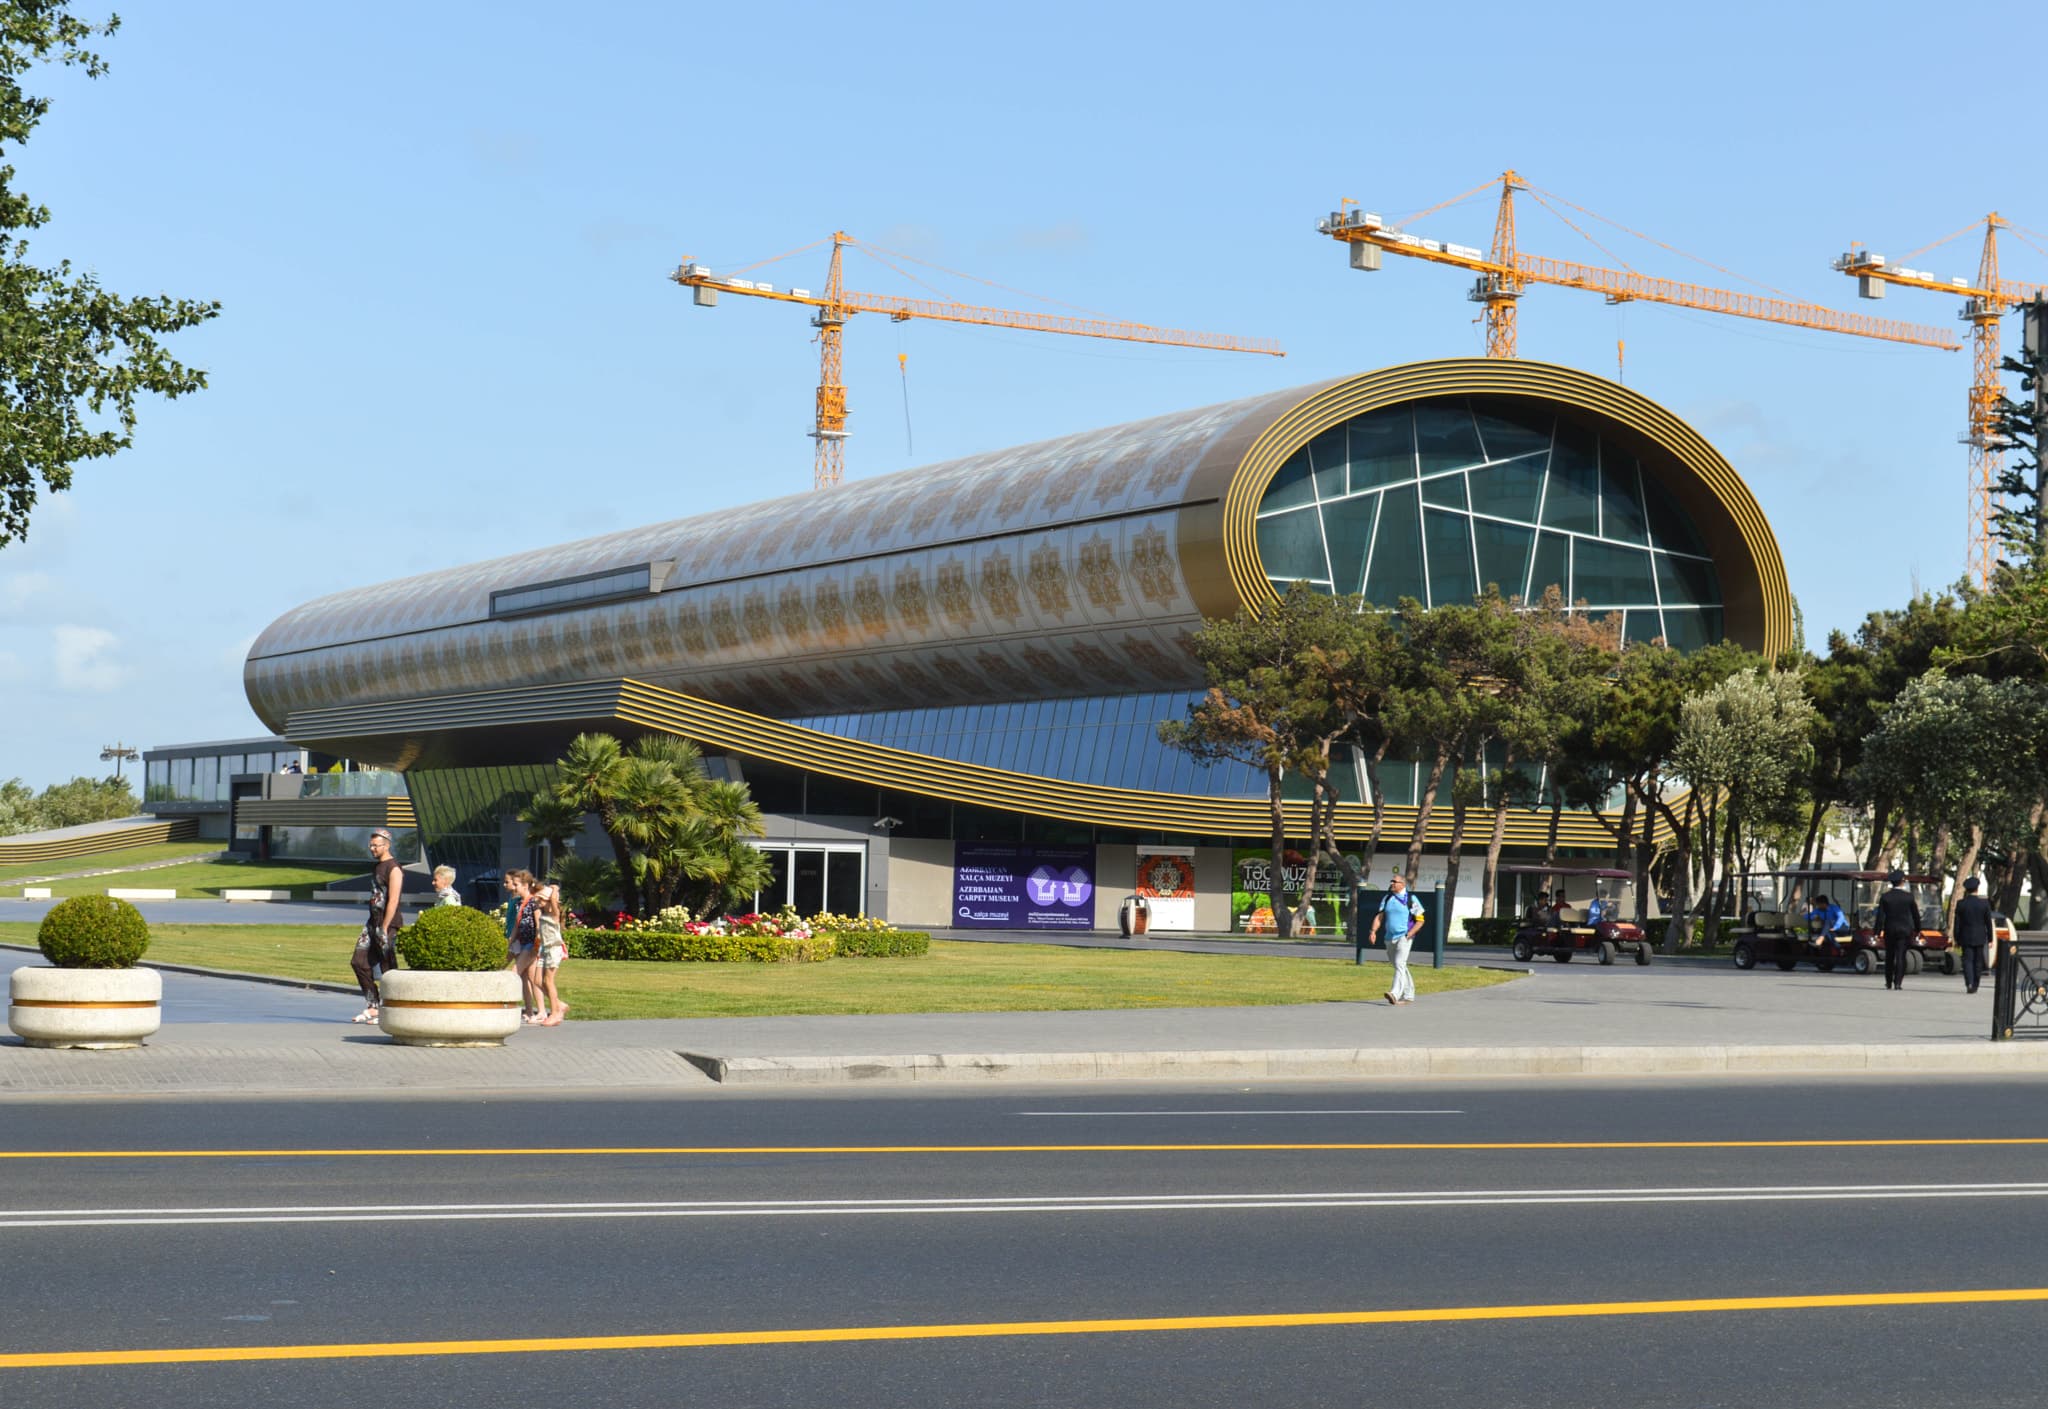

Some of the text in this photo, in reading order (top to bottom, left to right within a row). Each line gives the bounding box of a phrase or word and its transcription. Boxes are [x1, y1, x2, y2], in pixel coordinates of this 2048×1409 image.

[958, 886, 1004, 894] AZERBAIJAN
[958, 894, 1019, 903] CARPET MUSEUM
